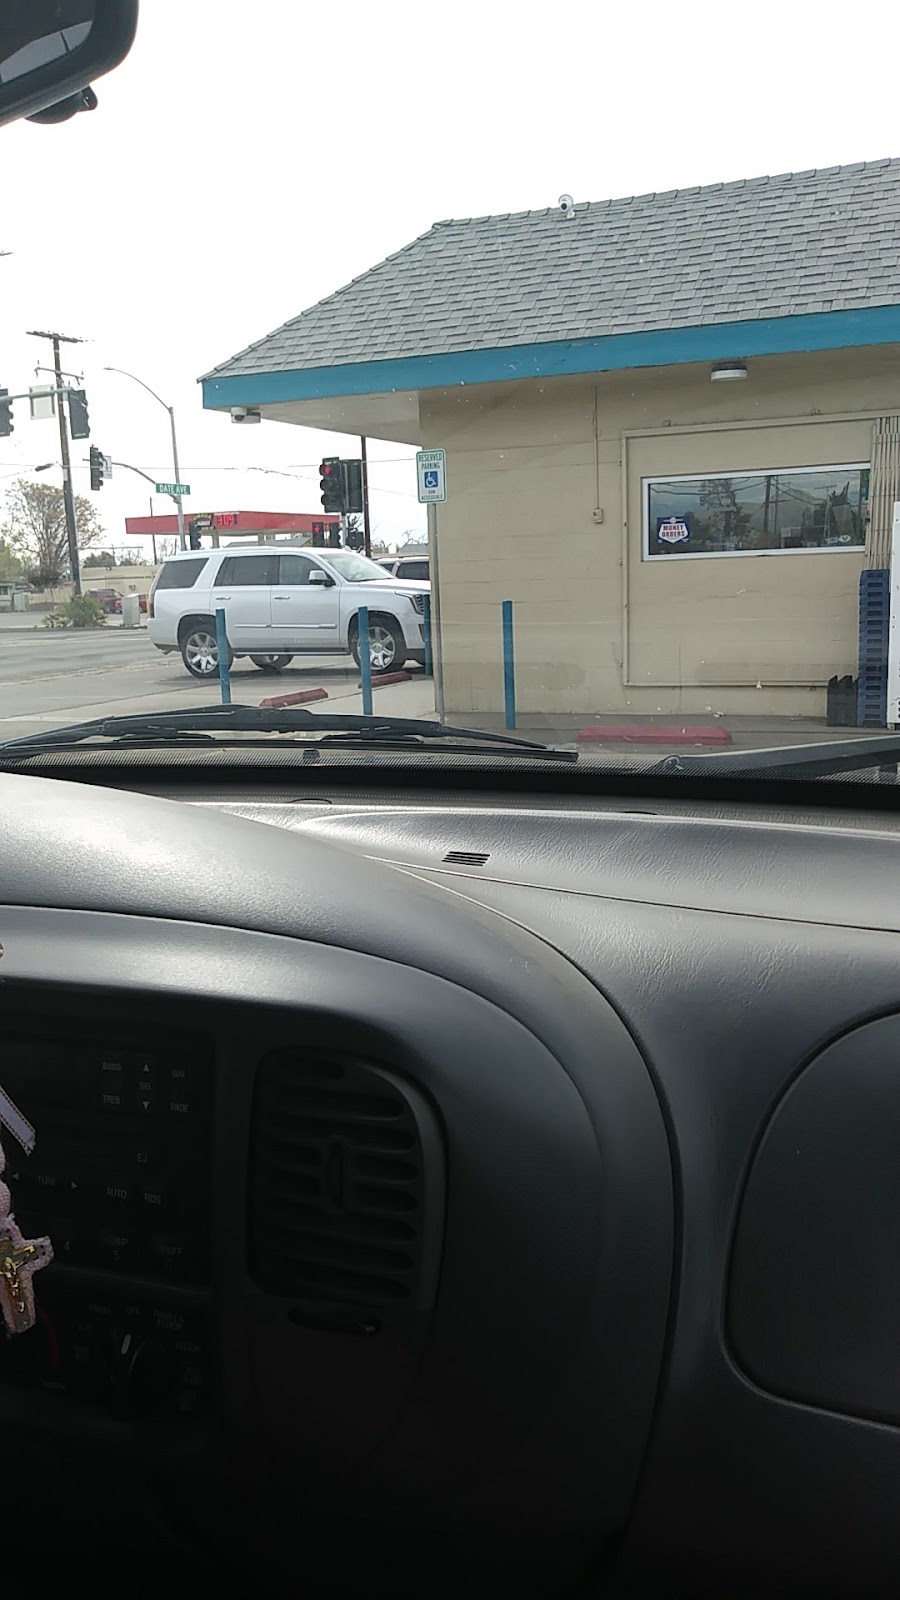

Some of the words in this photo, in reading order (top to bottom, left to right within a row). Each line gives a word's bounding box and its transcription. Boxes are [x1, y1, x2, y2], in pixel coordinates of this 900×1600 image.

[418, 453, 442, 461] RESERVED
[421, 462, 440, 470] PARKING
[160, 485, 174, 494] DATE
[176, 486, 187, 494] AVE
[102, 1062, 121, 1072] BASS
[102, 1094, 121, 1105] TREB
[170, 1103, 190, 1113] FADE
[137, 1153, 148, 1163] EJ
[106, 1187, 127, 1199] AUTO
[144, 1193, 161, 1205] RDS
[64, 1241, 70, 1251] 4
[113, 1250, 119, 1261] 5
